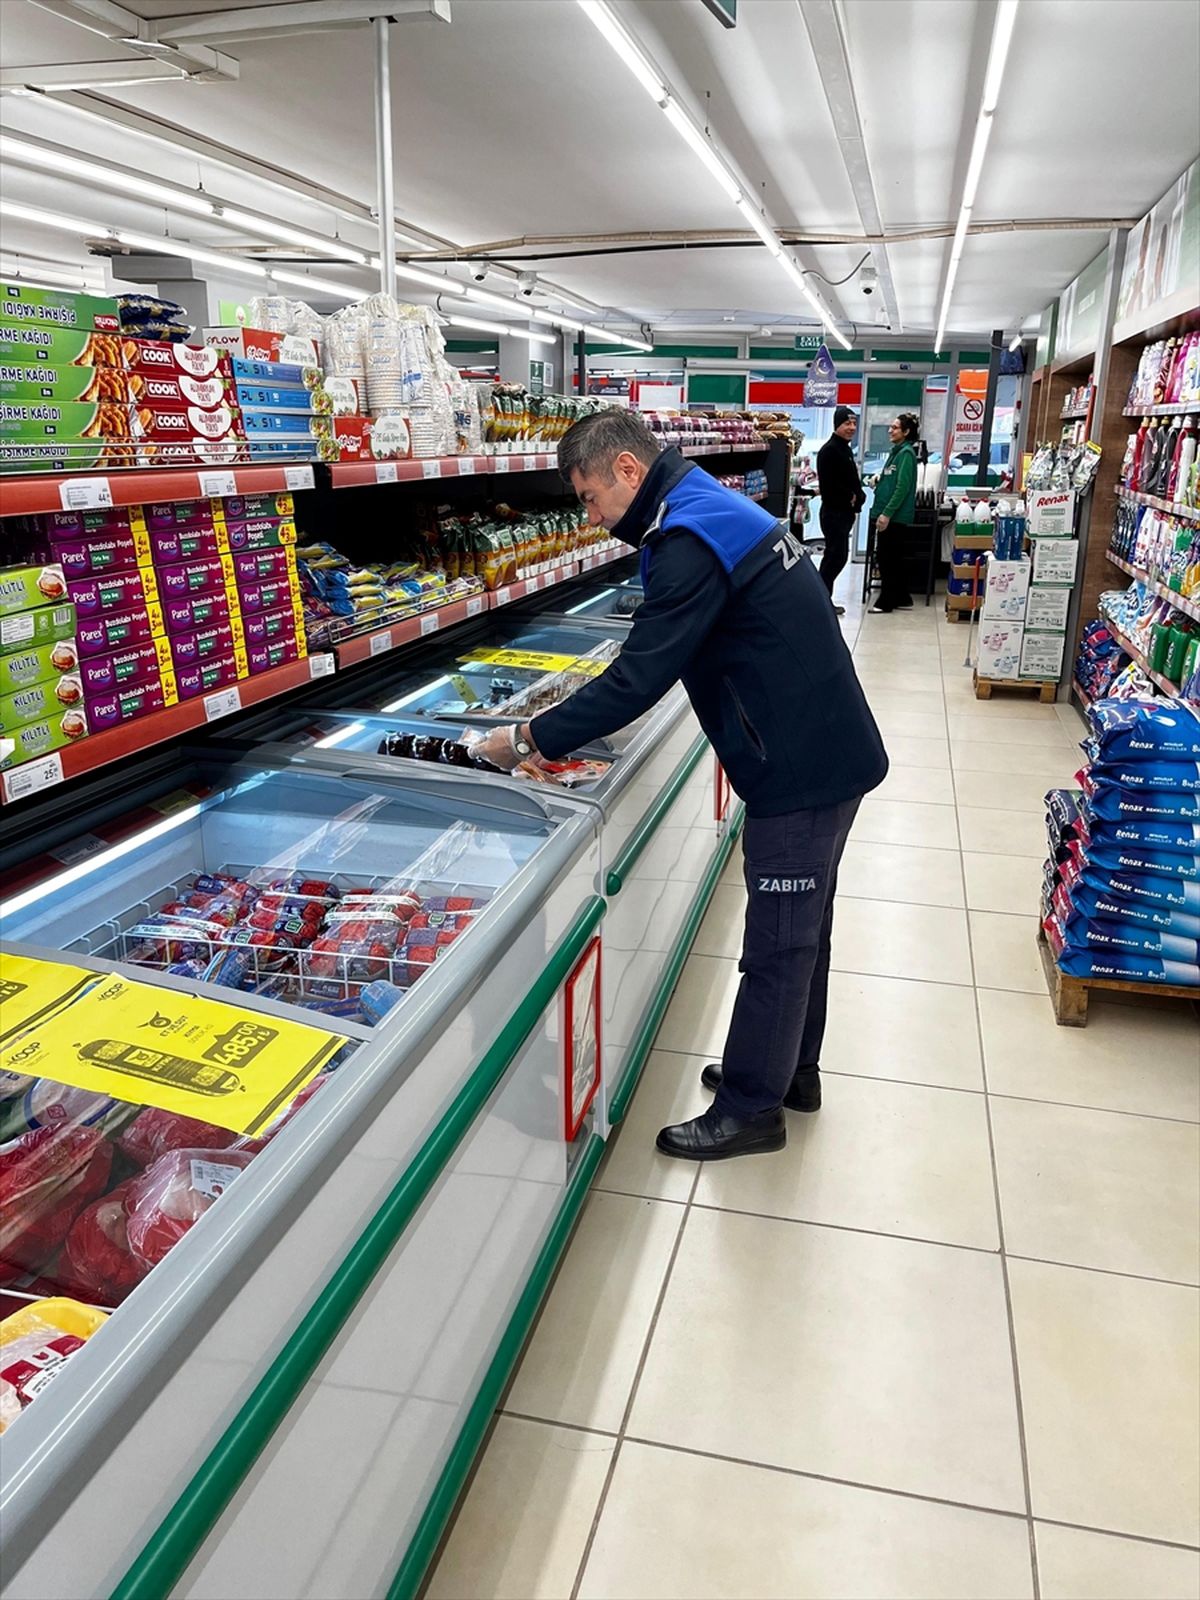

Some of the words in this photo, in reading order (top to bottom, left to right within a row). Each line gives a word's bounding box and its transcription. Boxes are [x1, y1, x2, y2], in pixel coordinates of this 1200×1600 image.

[143, 349, 171, 363] COOK
[149, 383, 177, 397] COOK
[157, 415, 186, 427] COOK
[1037, 494, 1070, 508] Renax
[62, 552, 85, 564] Parex
[73, 592, 96, 603] Parex
[81, 630, 103, 642] Parex
[88, 667, 110, 680] Parex
[94, 703, 117, 717] Parex
[1129, 740, 1155, 749] Renax
[1120, 774, 1144, 784] Renax
[1119, 802, 1144, 812] Renax
[1116, 829, 1140, 840] Renax
[1119, 856, 1143, 867] Renax
[758, 878, 816, 892] ZABITA
[1109, 879, 1133, 892] Renax
[1094, 900, 1119, 913] Renax
[1086, 931, 1110, 943] Renax
[1090, 964, 1114, 974] Renax
